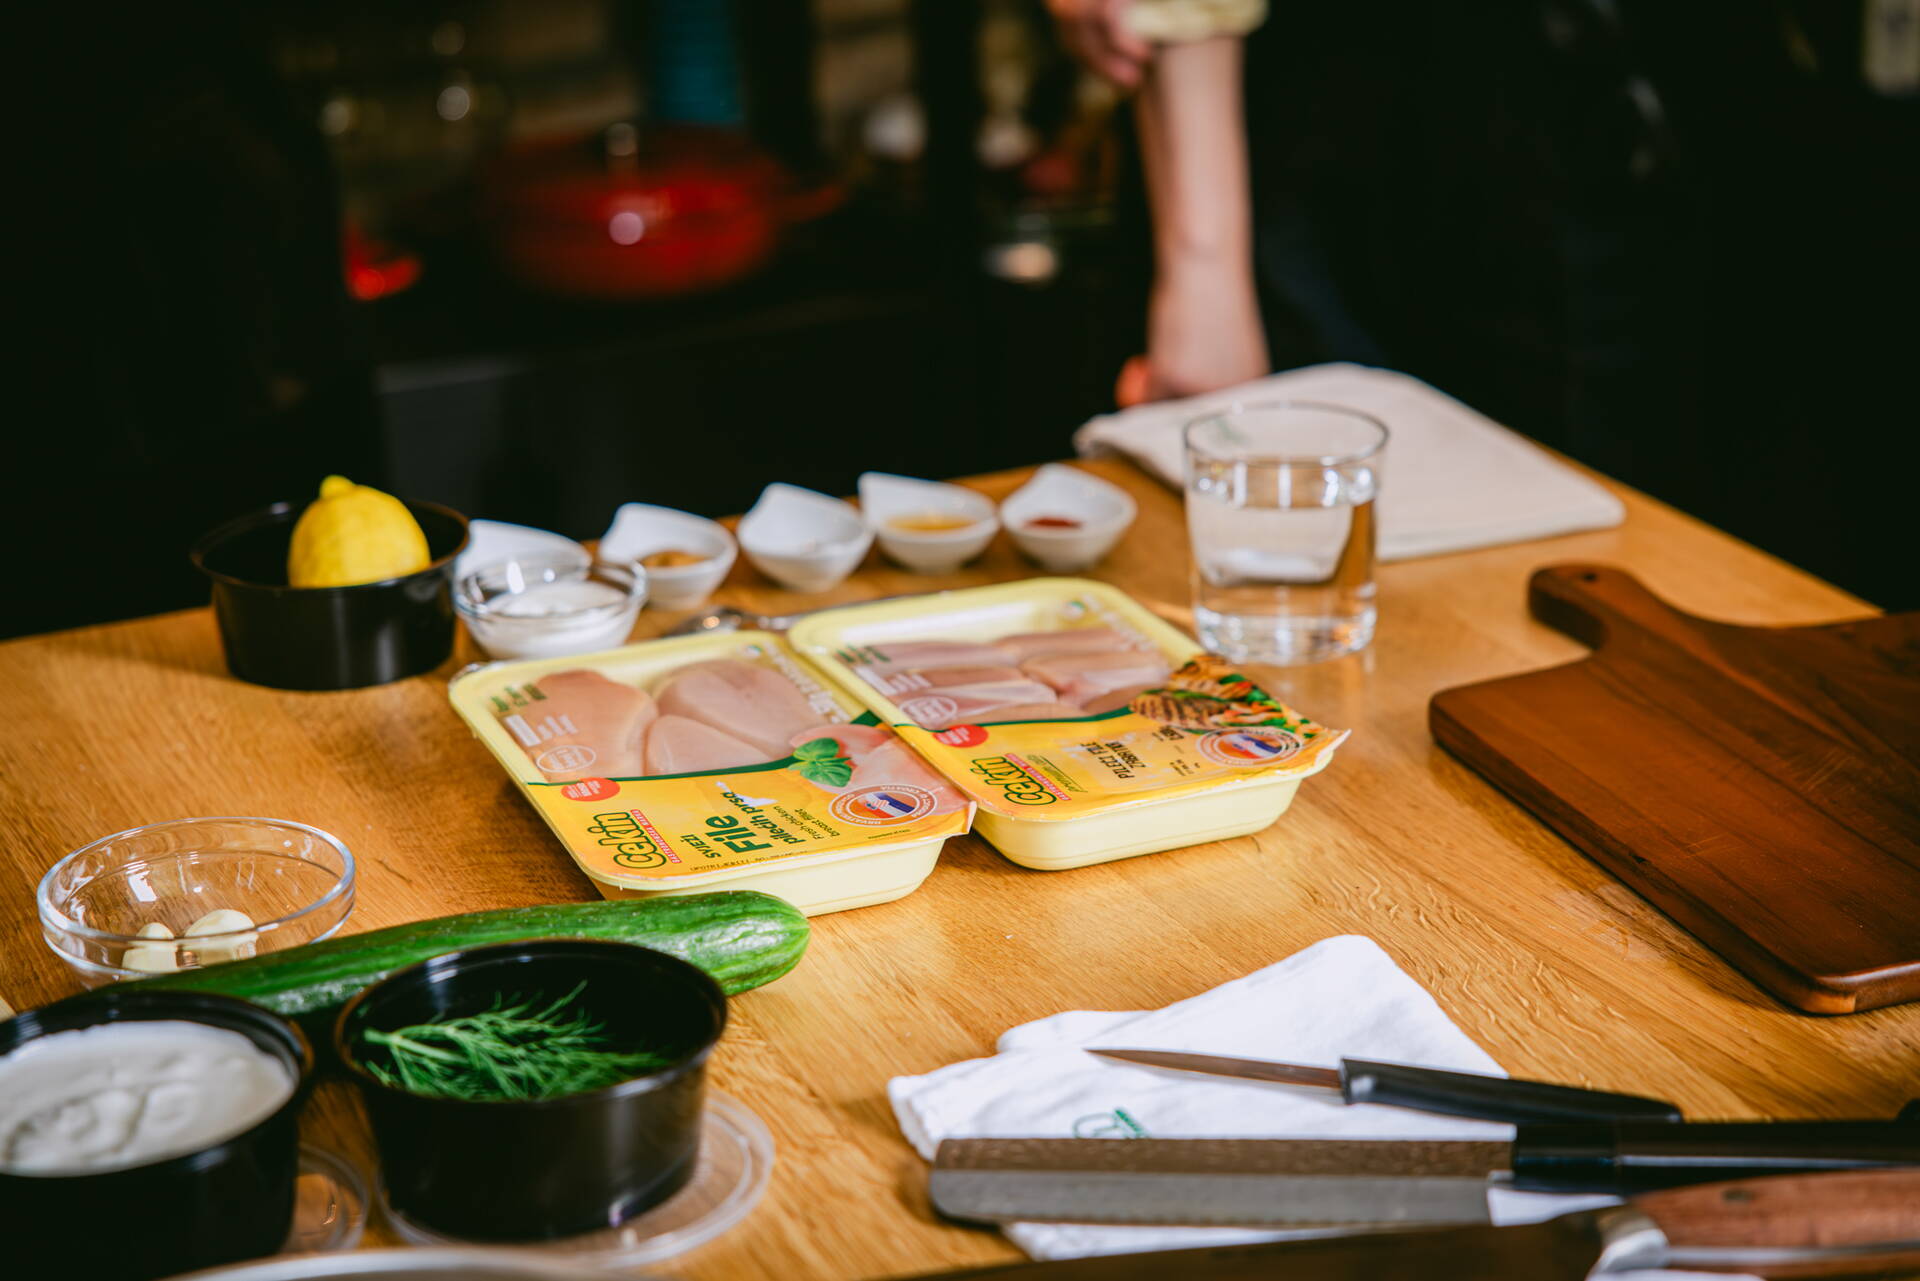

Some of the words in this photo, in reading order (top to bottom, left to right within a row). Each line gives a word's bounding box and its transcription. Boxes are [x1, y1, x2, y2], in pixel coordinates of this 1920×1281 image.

[970, 757, 1057, 805] Cekin
[721, 791, 763, 814] prsa
[587, 812, 667, 869] Cekin
[705, 815, 774, 853] File
[750, 815, 807, 844] pilećih
[799, 823, 825, 840] Fresh
